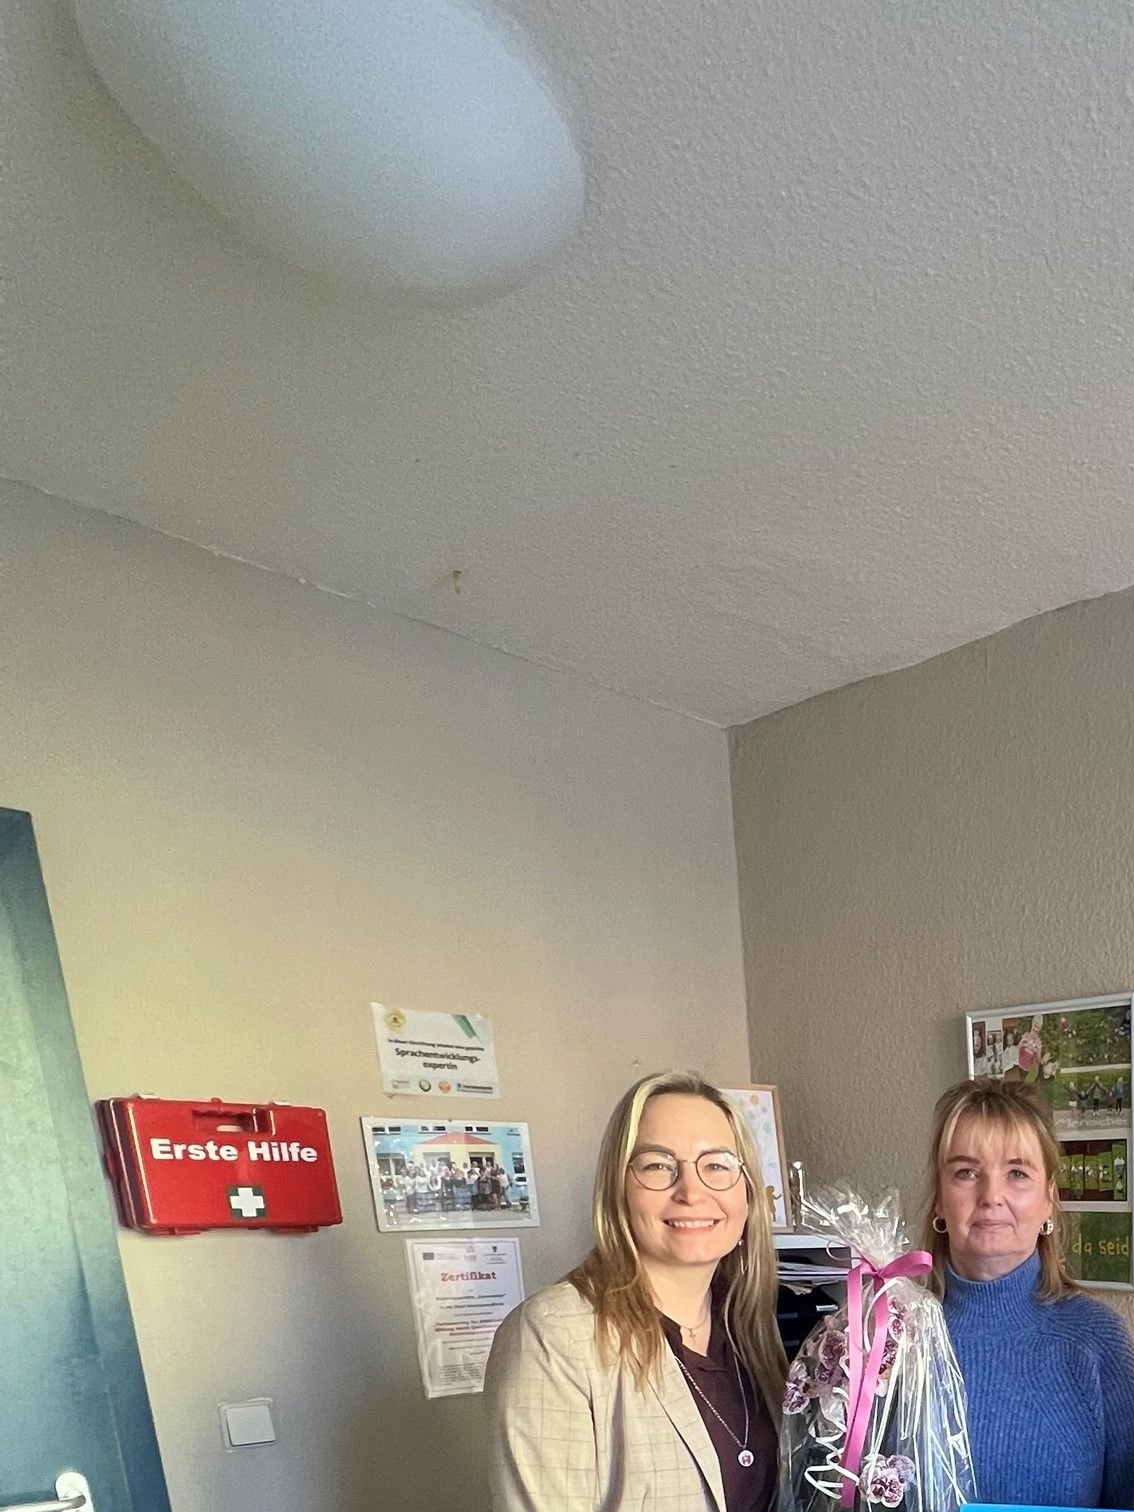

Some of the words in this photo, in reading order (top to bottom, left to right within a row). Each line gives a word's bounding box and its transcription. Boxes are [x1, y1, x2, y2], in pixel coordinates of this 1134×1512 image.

[149, 1137, 239, 1161] Erste
[247, 1140, 318, 1162] Hilfe
[1072, 1233, 1093, 1255] da
[1098, 1234, 1130, 1257] seid
[440, 1271, 497, 1282] Zertifikat
